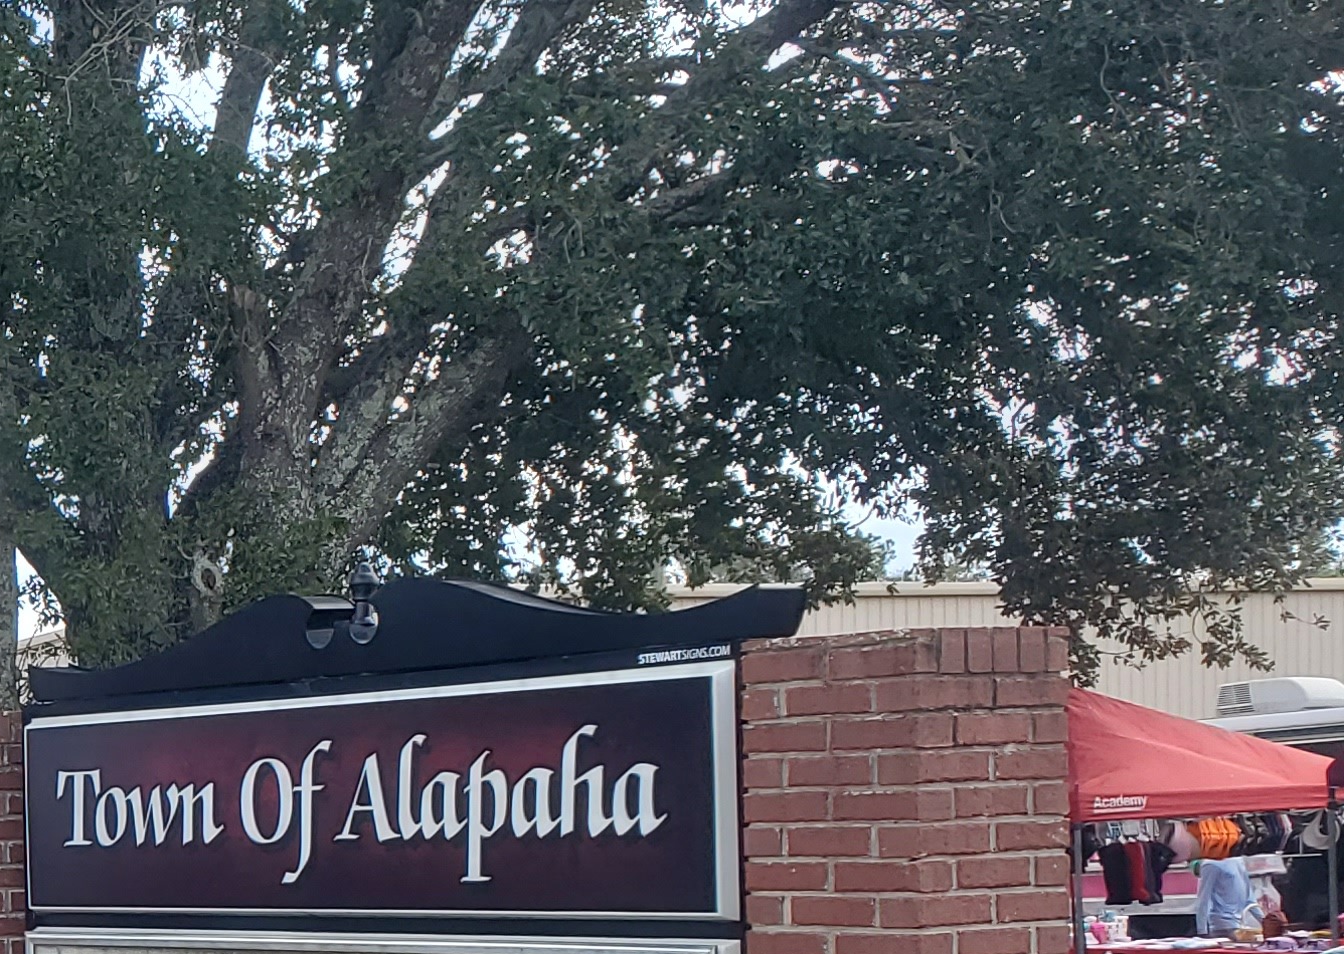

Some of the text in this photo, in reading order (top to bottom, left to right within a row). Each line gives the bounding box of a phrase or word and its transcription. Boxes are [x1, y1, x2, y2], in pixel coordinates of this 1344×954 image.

[637, 645, 731, 665] STEWARTSIGNS.COM
[56, 724, 668, 885] Town Of Alapaha
[1093, 793, 1148, 810] Academy
